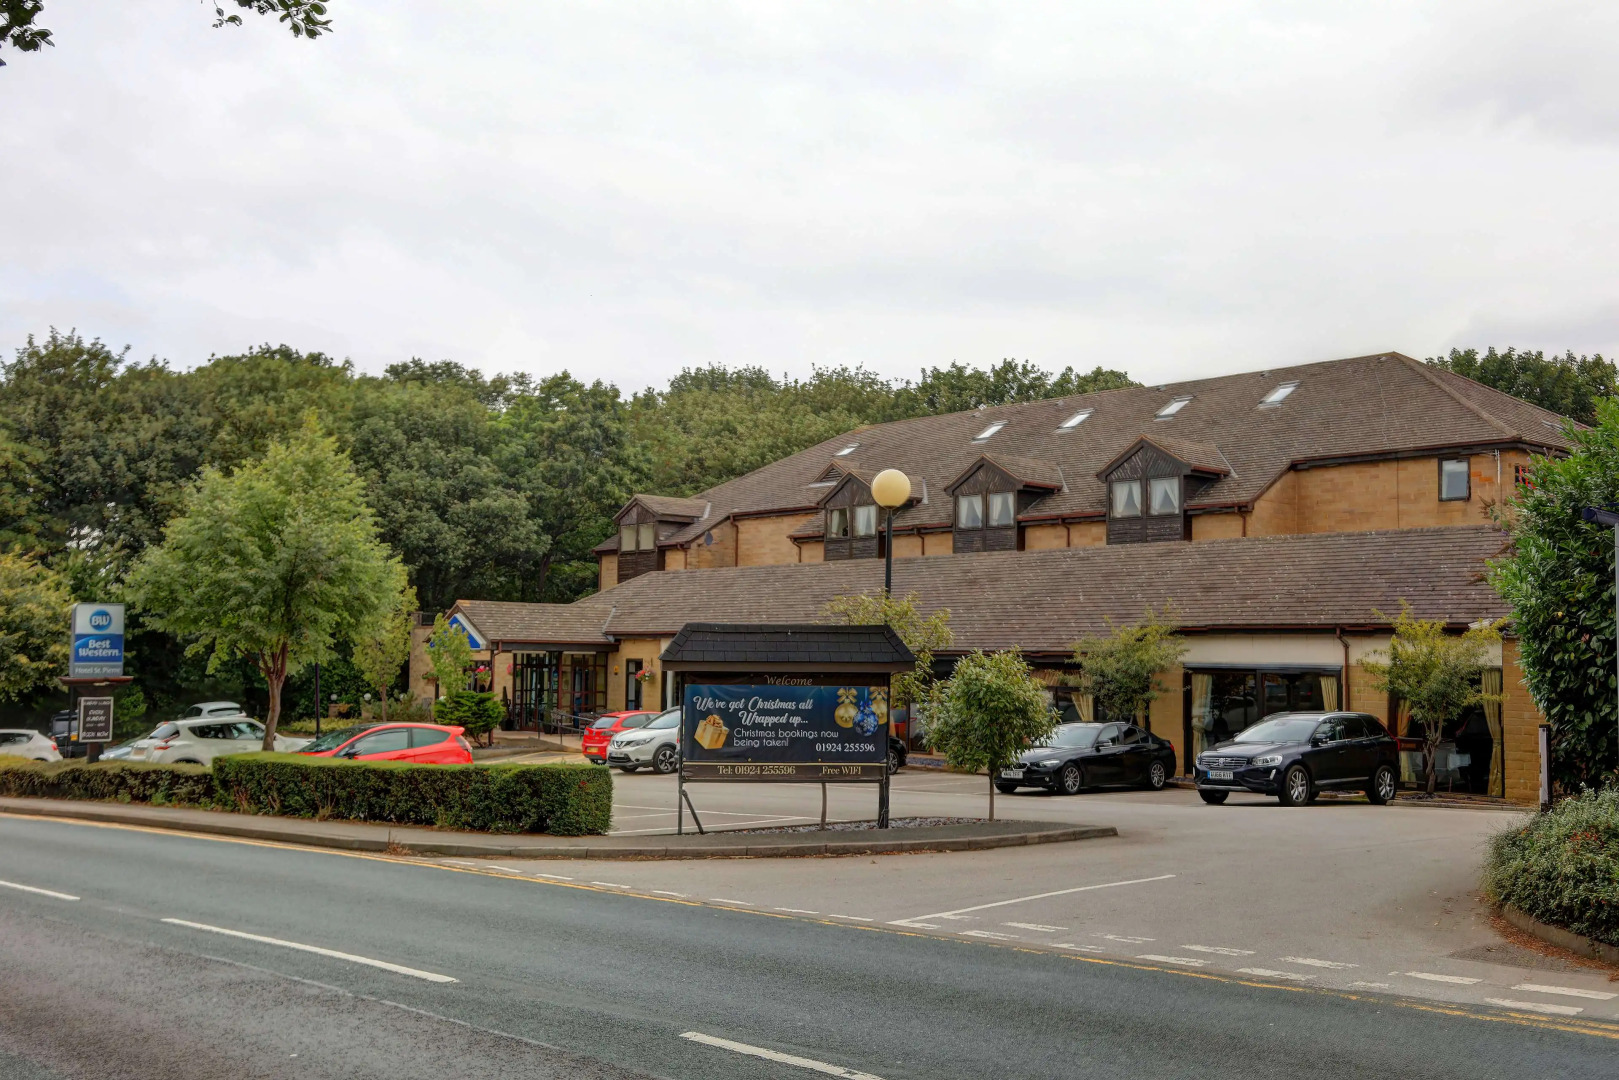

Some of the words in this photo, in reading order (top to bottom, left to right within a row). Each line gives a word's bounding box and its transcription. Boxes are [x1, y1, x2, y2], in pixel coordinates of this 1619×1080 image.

[91, 614, 110, 626] BW
[88, 640, 111, 649] Best
[78, 648, 119, 657] Western
[75, 666, 93, 674] Hotel
[763, 674, 813, 686] Welcome
[692, 695, 727, 711] We've
[728, 698, 746, 712] got
[747, 696, 797, 712] Christmas
[798, 698, 814, 710] all
[738, 711, 788, 727] Wrapped
[733, 728, 776, 738] Christmas
[778, 728, 818, 739] bookings
[733, 737, 760, 748] being
[763, 738, 789, 747] taken!
[815, 742, 842, 752] 01924
[843, 743, 876, 752] 255596
[717, 765, 733, 775] Tel:
[734, 765, 761, 775] 01924
[761, 765, 796, 775] 255596
[822, 766, 840, 775] Free
[841, 766, 862, 775] WIFI
